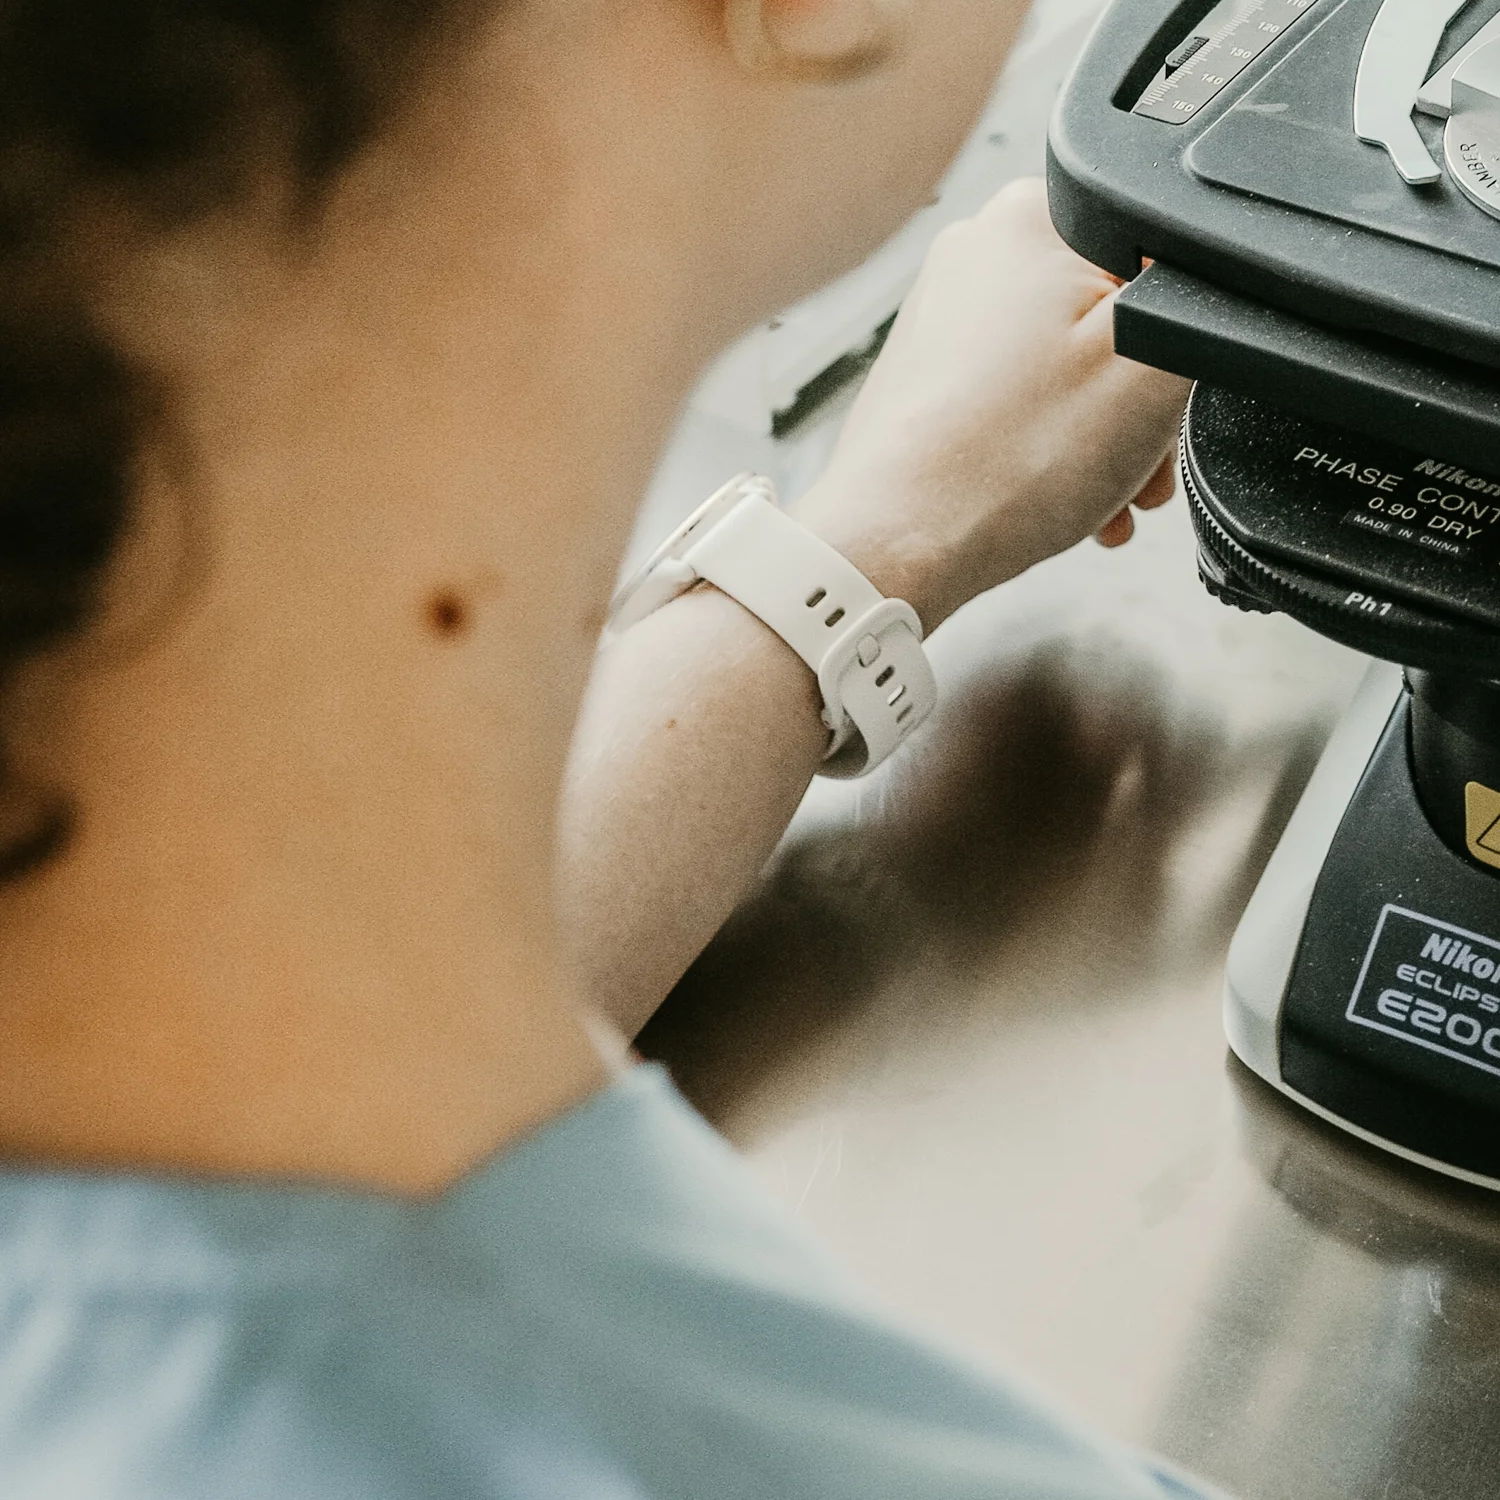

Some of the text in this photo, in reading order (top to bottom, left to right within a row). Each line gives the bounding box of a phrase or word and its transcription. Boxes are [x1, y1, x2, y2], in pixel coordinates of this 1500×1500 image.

[1257, 21, 1281, 34] 120
[1229, 46, 1252, 61] 130
[1200, 72, 1225, 86] 140
[1171, 99, 1196, 113] 150
[1293, 446, 1403, 493] PHASE
[1367, 496, 1483, 541] 0.90 DRY
[1353, 514, 1460, 554] MADE IN CHINA
[1344, 591, 1394, 617] Ph1
